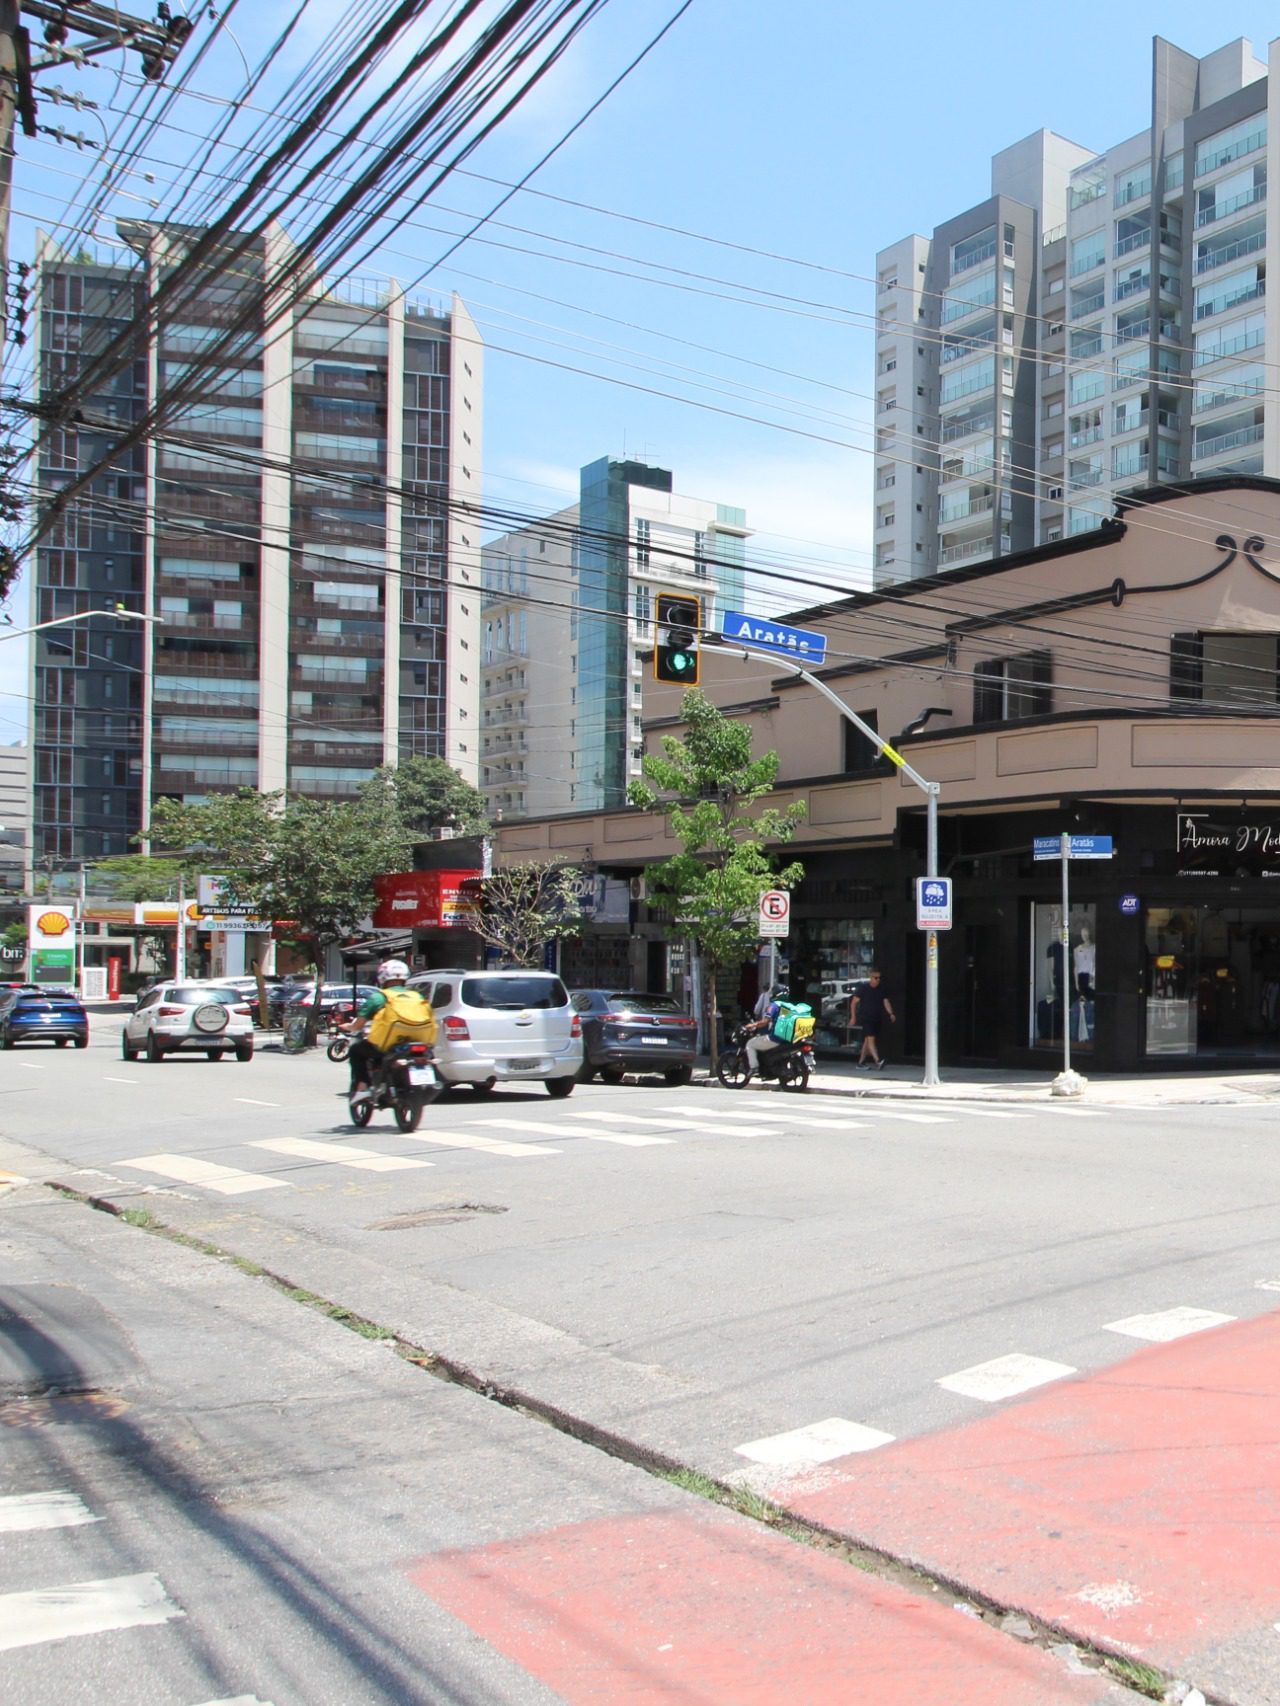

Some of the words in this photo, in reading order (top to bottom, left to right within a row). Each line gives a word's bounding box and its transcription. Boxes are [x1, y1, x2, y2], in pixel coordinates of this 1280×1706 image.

[738, 621, 809, 654] Aratãs
[1071, 838, 1095, 848] Aratãs
[1181, 824, 1230, 849] Amora
[1122, 898, 1137, 906] ADT
